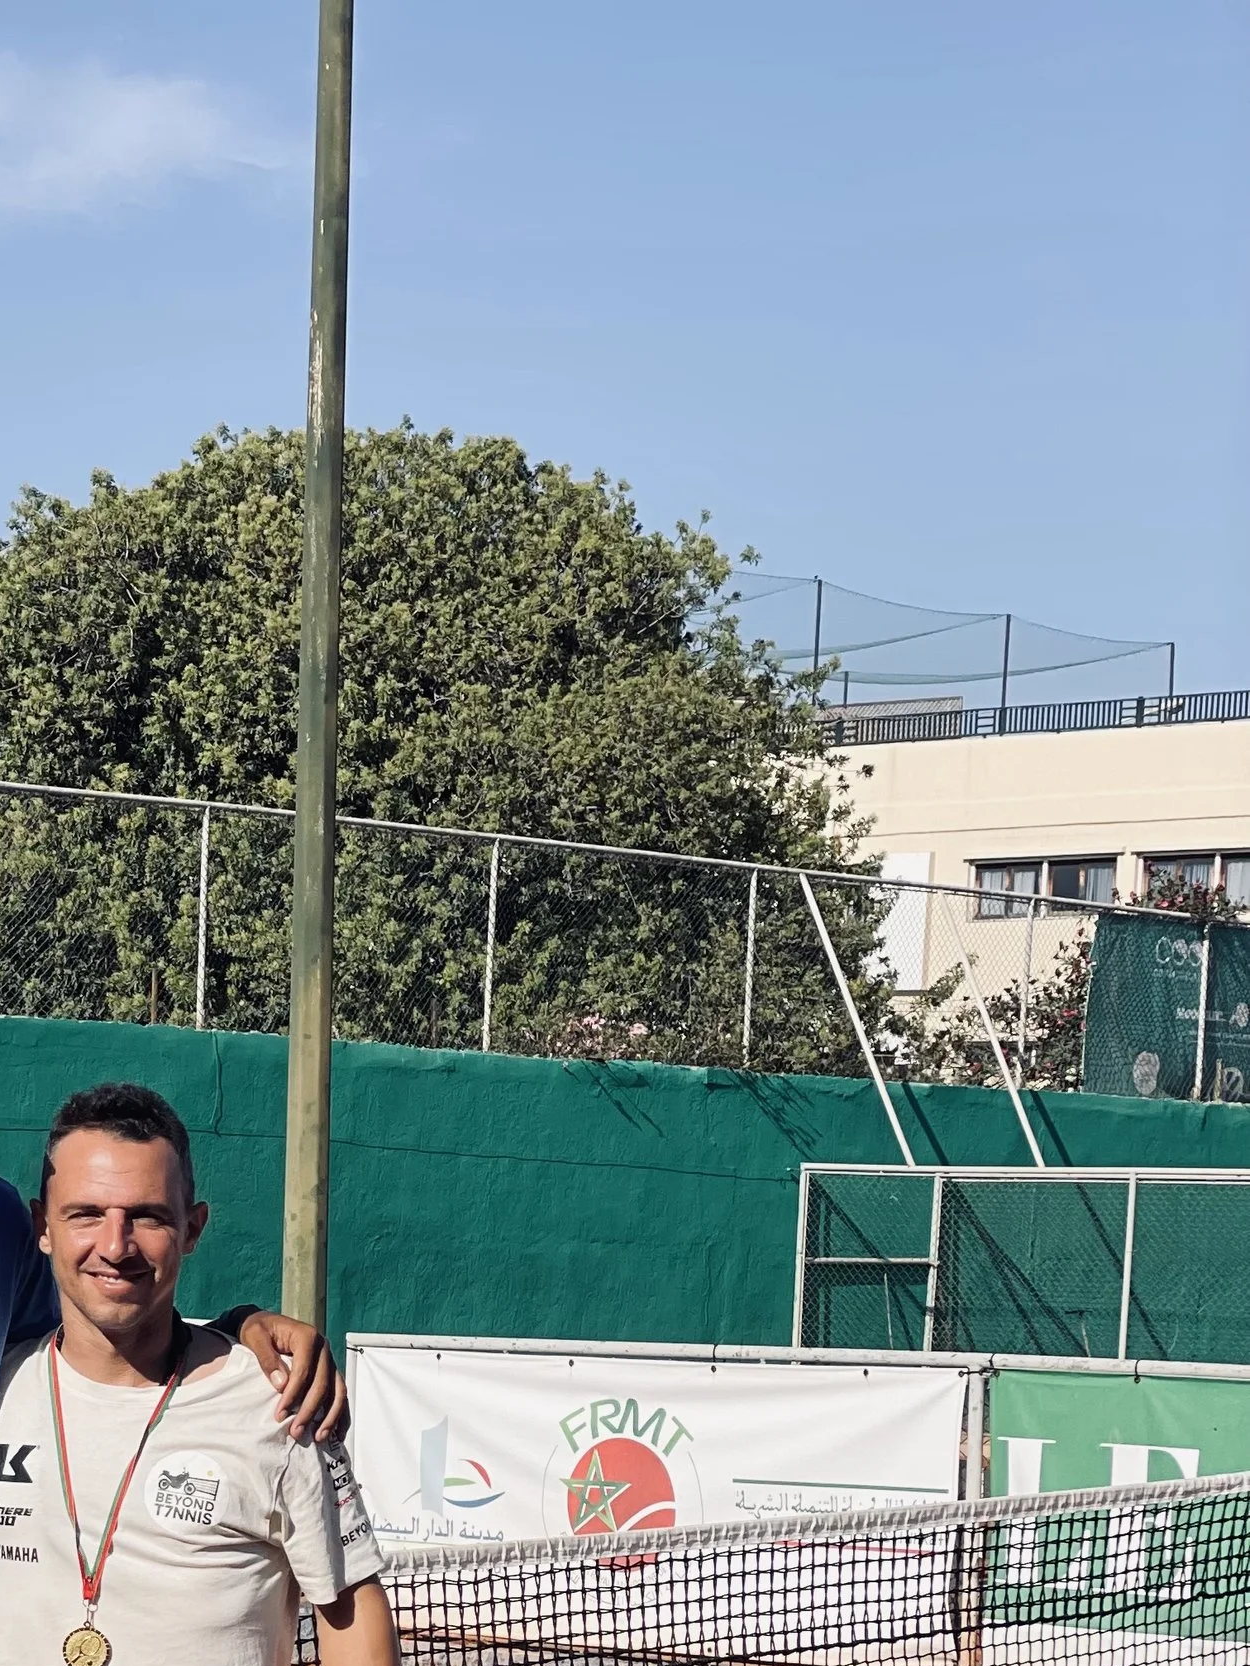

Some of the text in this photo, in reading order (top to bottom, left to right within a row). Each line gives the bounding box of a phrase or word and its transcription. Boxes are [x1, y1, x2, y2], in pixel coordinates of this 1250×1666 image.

[559, 1398, 695, 1458] FRMT
[155, 1491, 215, 1512] BEYOND
[154, 1503, 213, 1525] T7NNIS
[372, 1513, 420, 1540] البيضا
[423, 1518, 454, 1541] الدار
